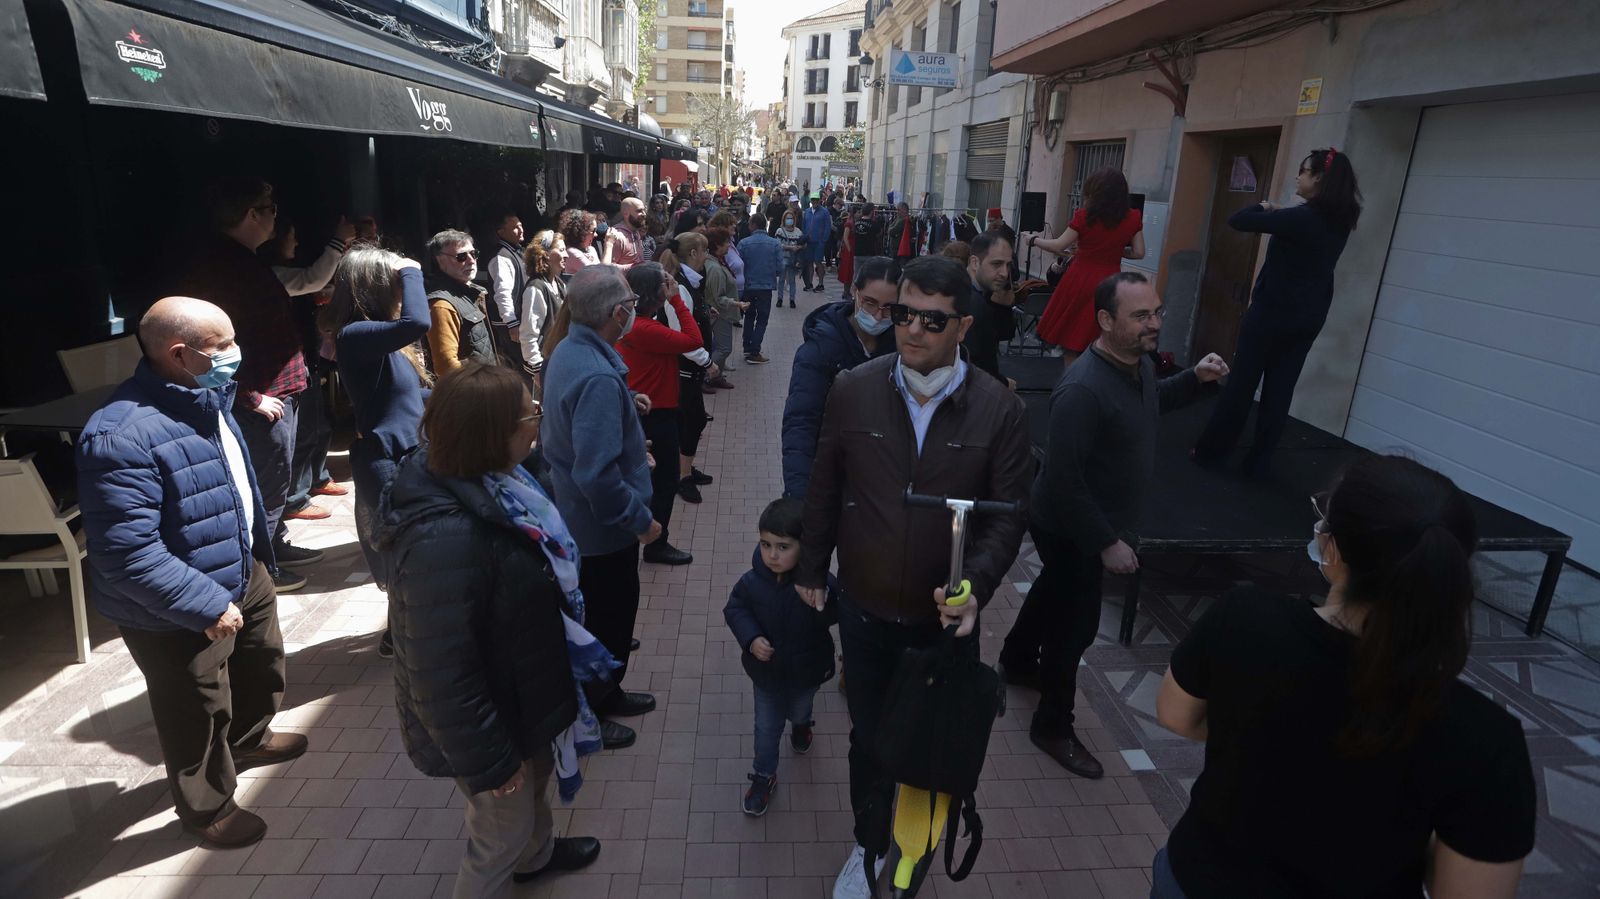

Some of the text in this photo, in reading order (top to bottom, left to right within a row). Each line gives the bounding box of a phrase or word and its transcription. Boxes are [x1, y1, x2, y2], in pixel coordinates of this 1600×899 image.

[119, 44, 163, 65] Heineken
[918, 55, 945, 65] aura
[918, 66, 951, 75] seguros
[406, 86, 453, 132] Vogg
